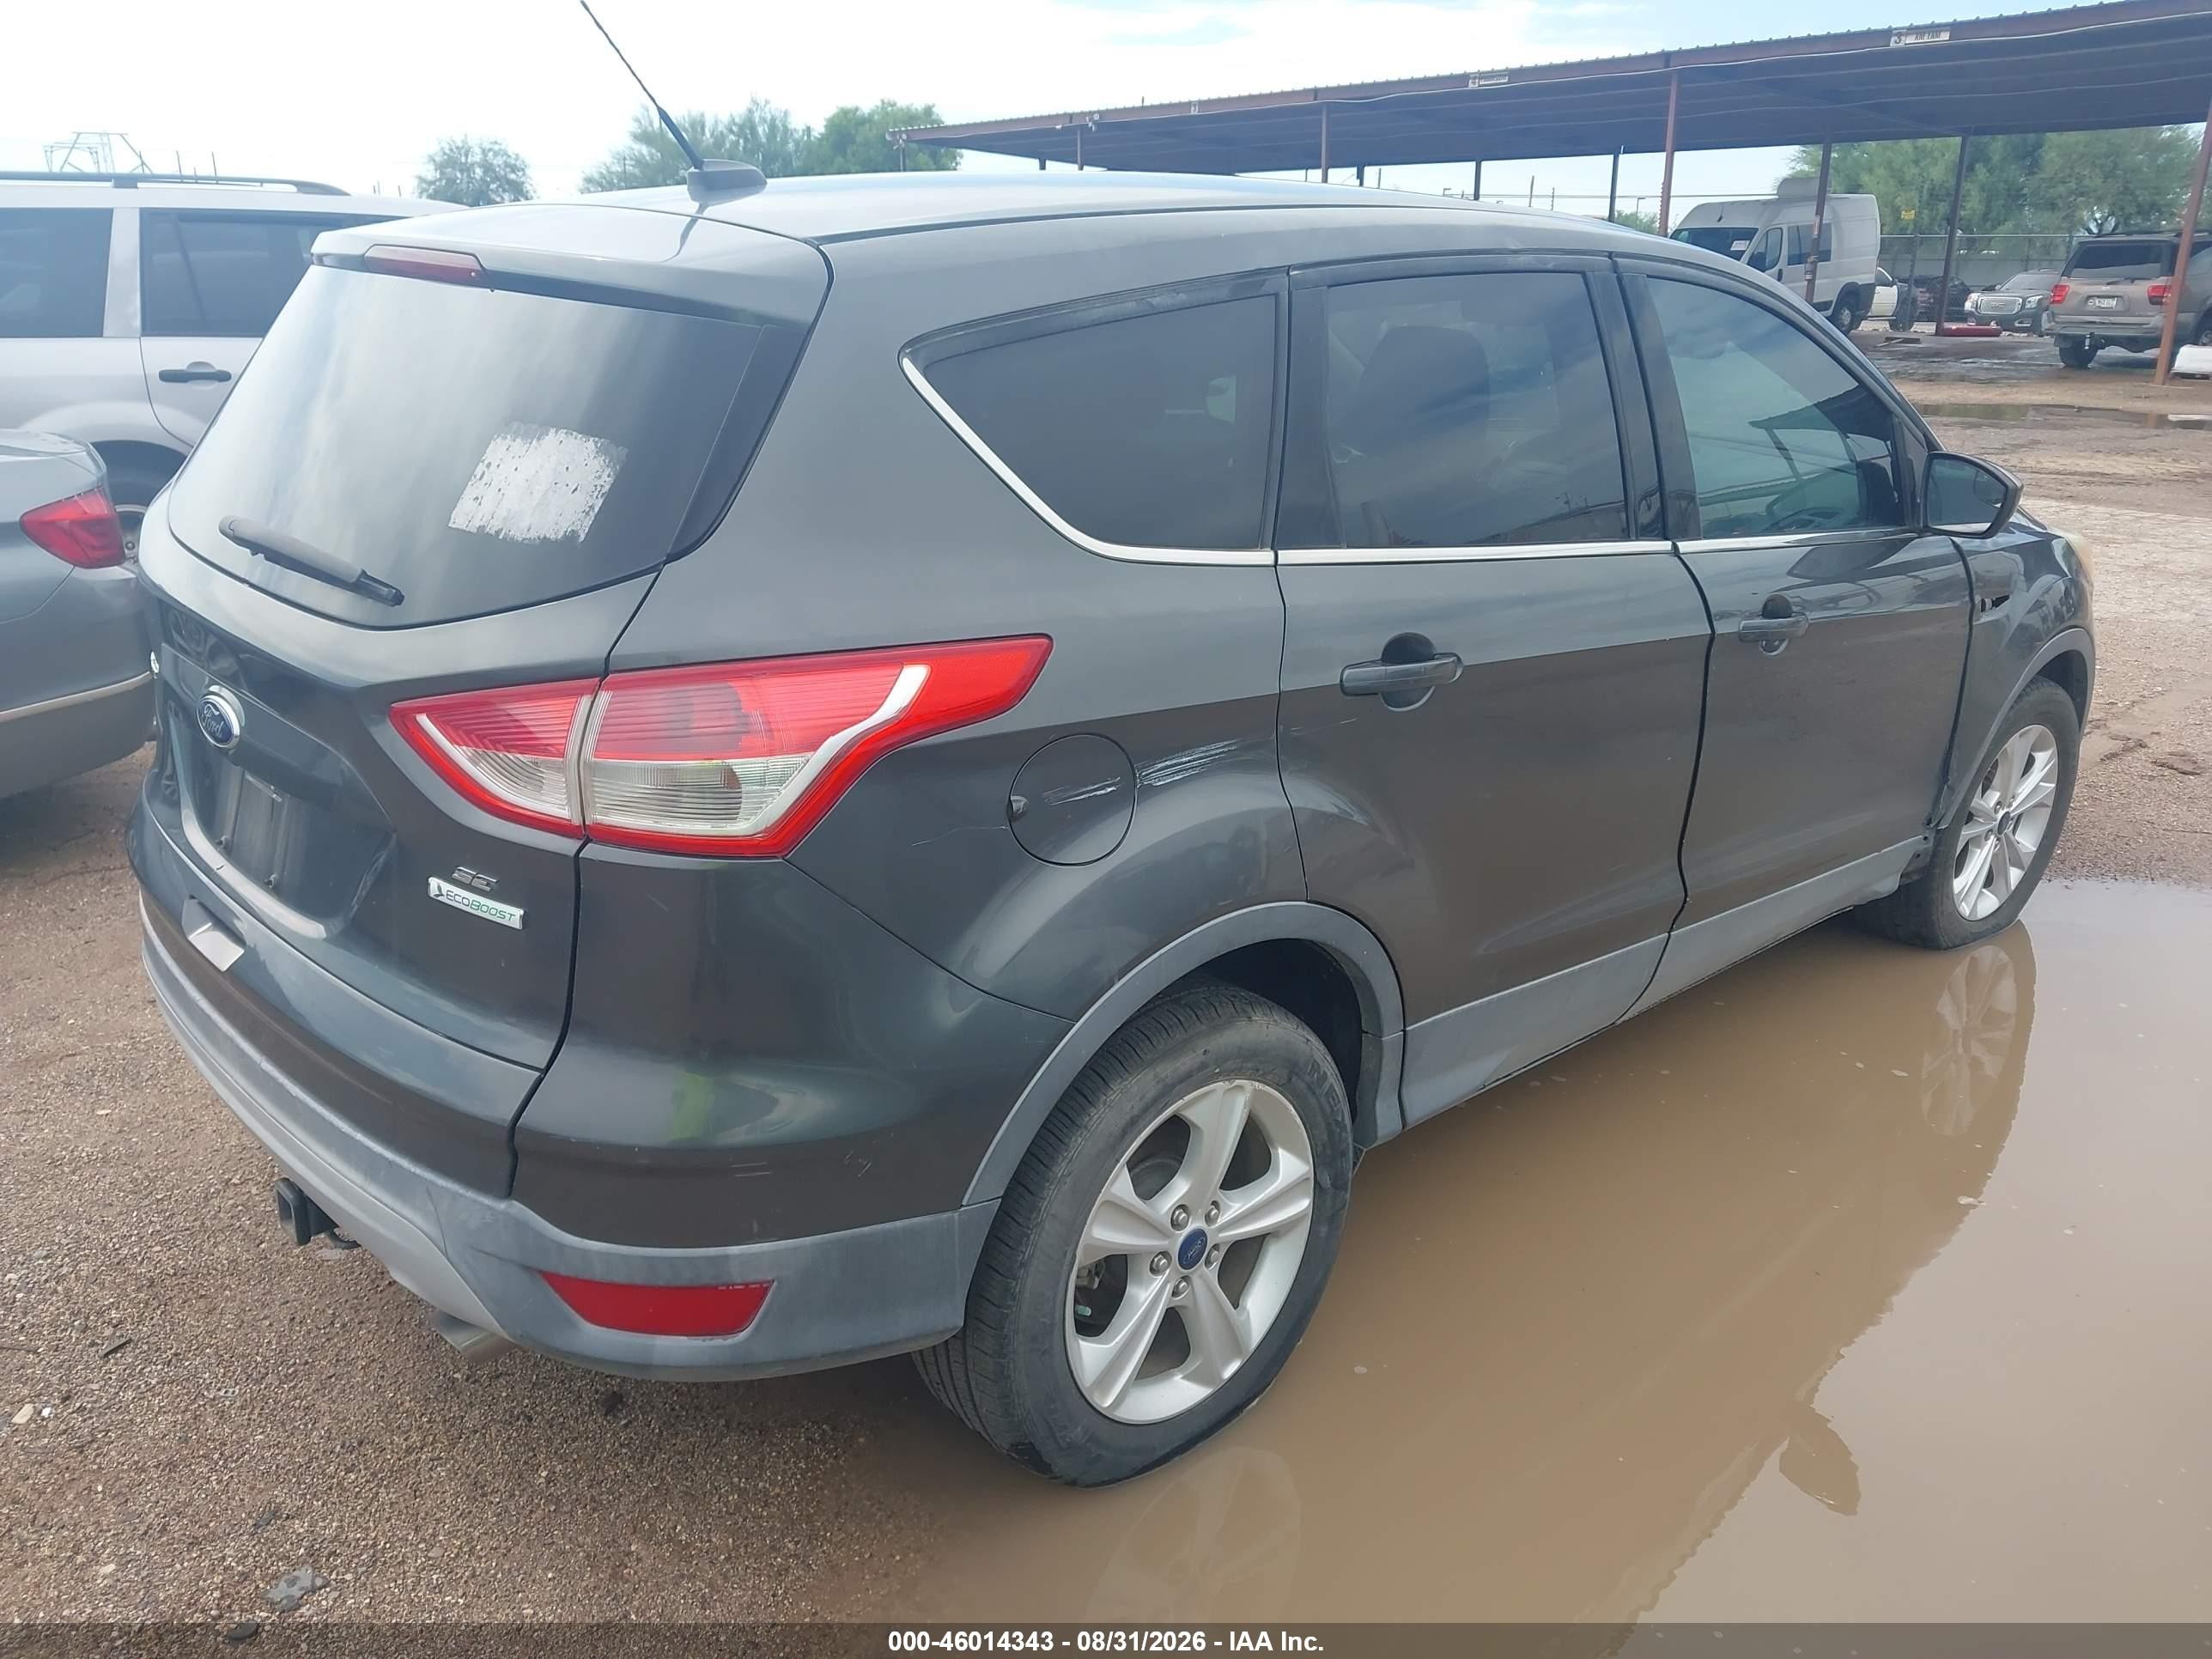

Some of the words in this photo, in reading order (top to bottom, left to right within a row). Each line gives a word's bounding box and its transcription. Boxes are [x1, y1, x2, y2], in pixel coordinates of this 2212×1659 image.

[201, 703, 225, 738] Ford
[452, 866, 499, 892] SE
[446, 889, 516, 921] ECOBOOST
